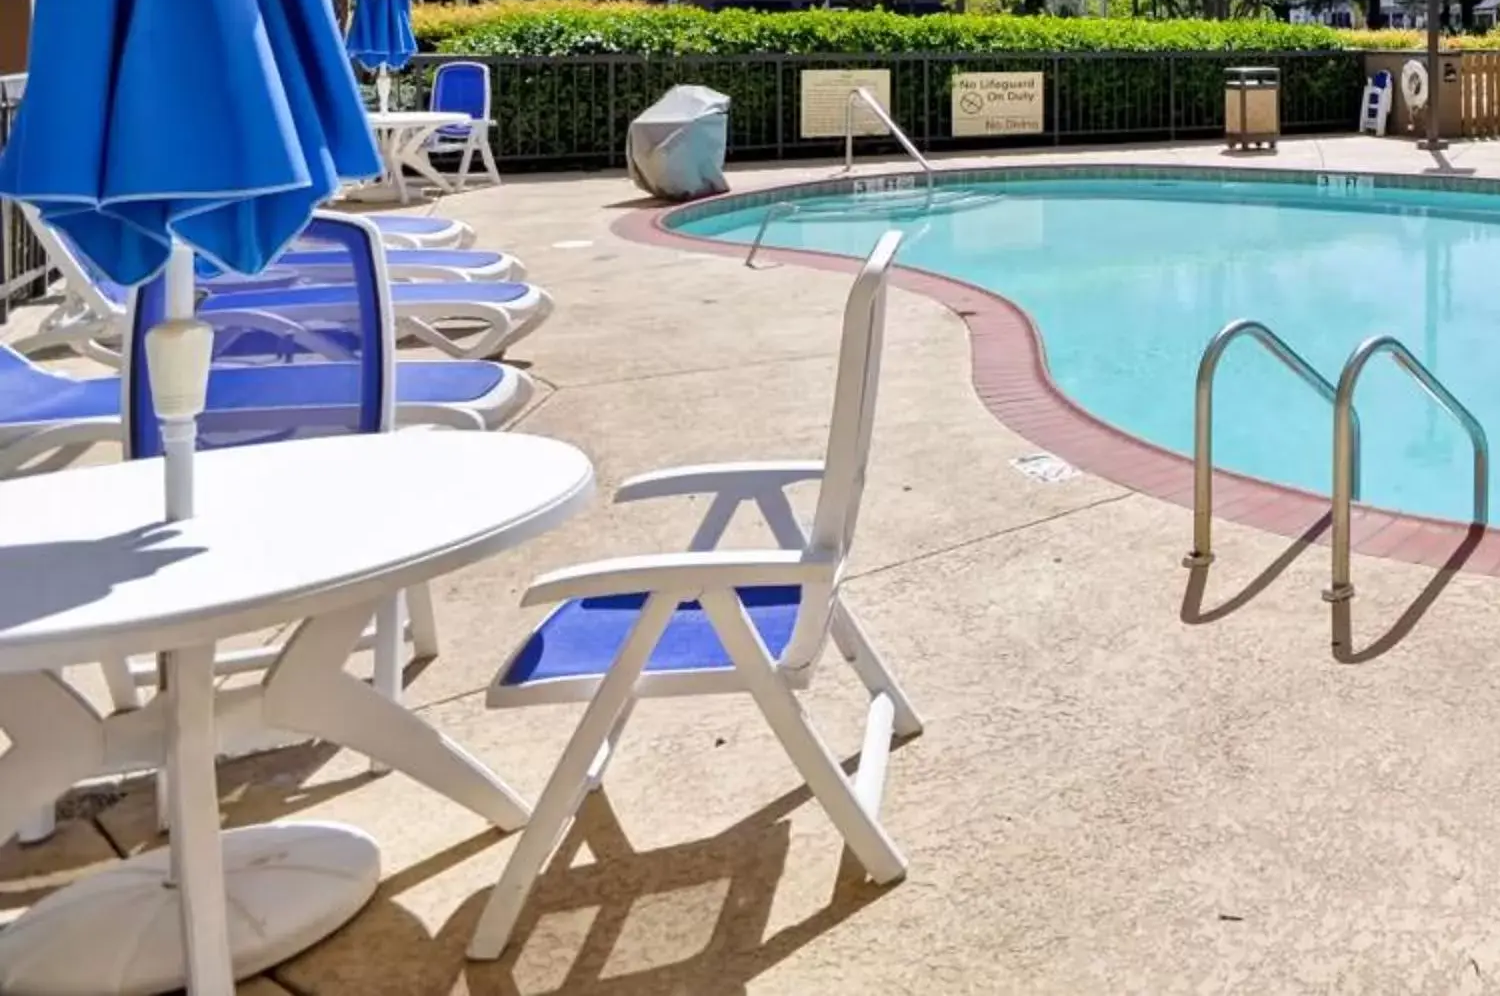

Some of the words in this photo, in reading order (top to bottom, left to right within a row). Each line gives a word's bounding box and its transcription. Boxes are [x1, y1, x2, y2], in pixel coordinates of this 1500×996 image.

[960, 80, 977, 90] No
[979, 78, 1035, 91] Lifeguard
[987, 92, 1004, 102] On
[1007, 91, 1035, 102] Duty
[985, 119, 1004, 130] No
